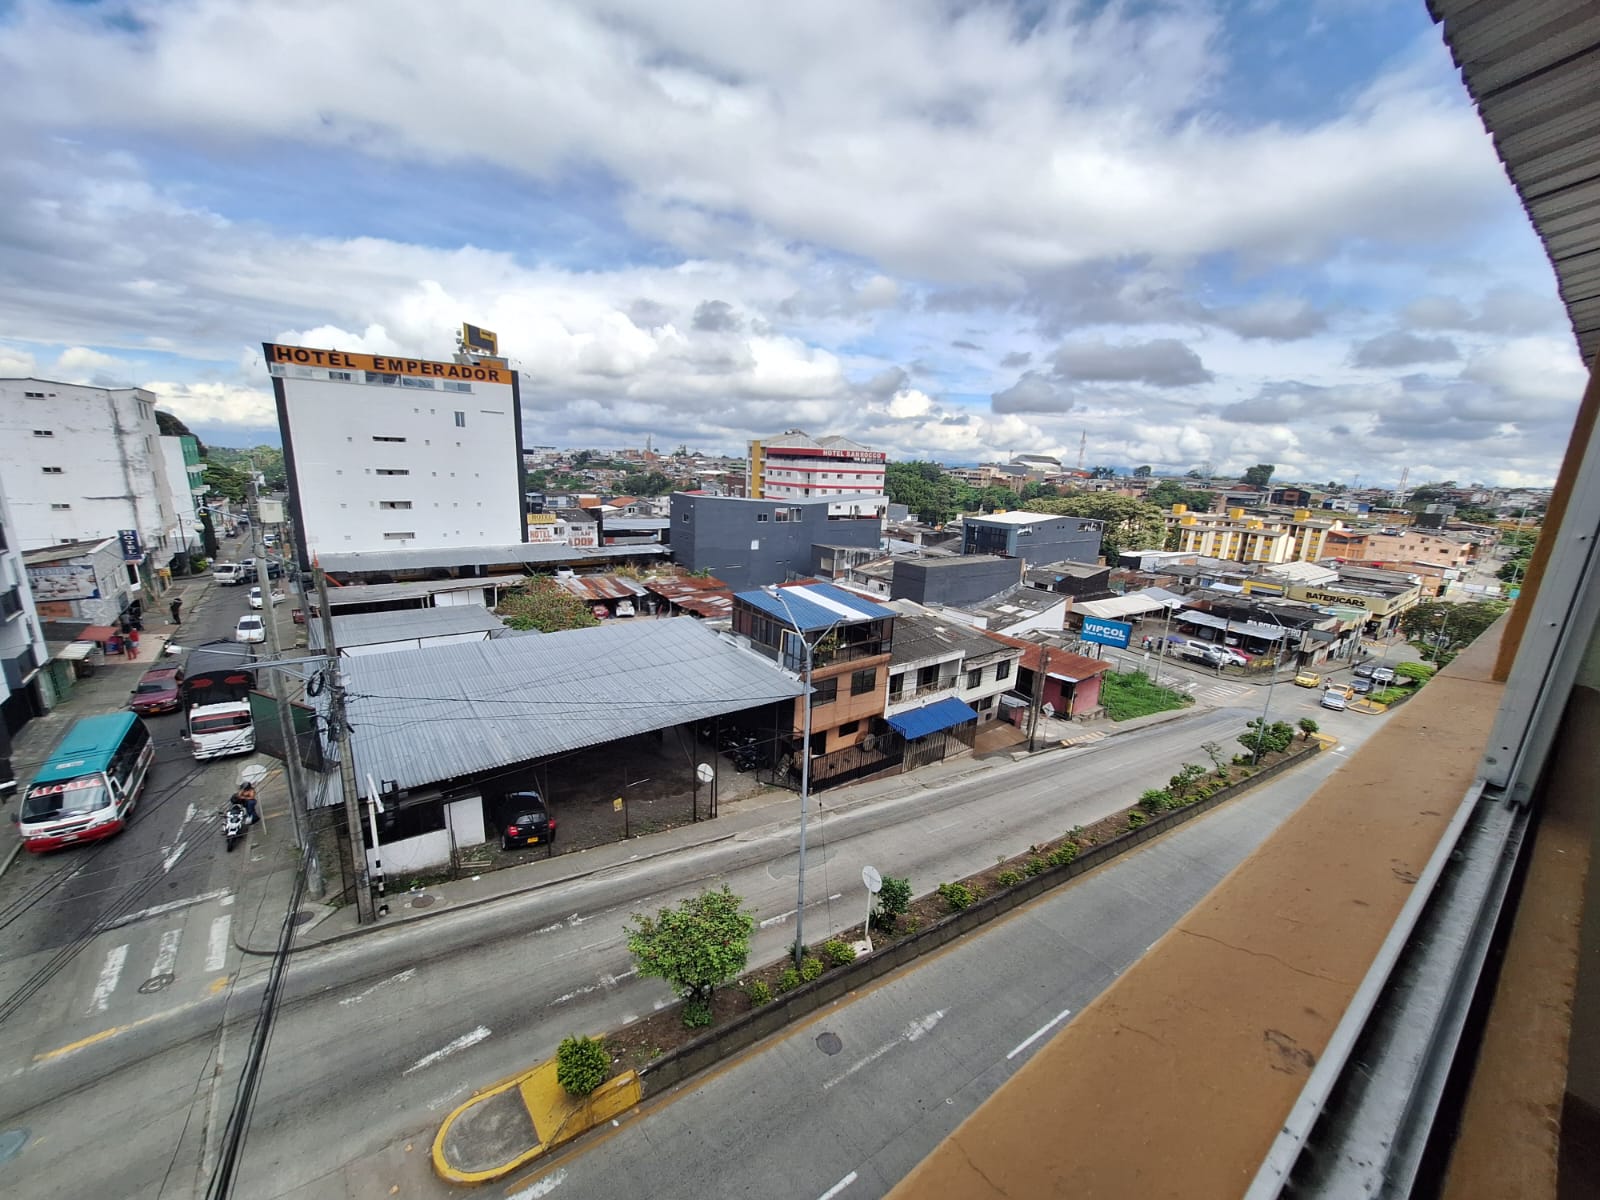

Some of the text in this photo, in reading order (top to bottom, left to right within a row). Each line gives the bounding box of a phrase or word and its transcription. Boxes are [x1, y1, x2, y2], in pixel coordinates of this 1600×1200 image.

[277, 346, 499, 382] HOTEL EMPERADOR
[123, 530, 137, 555] HOTEL
[1306, 591, 1366, 607] BATERICARS
[1085, 623, 1126, 638] VIPCOL
